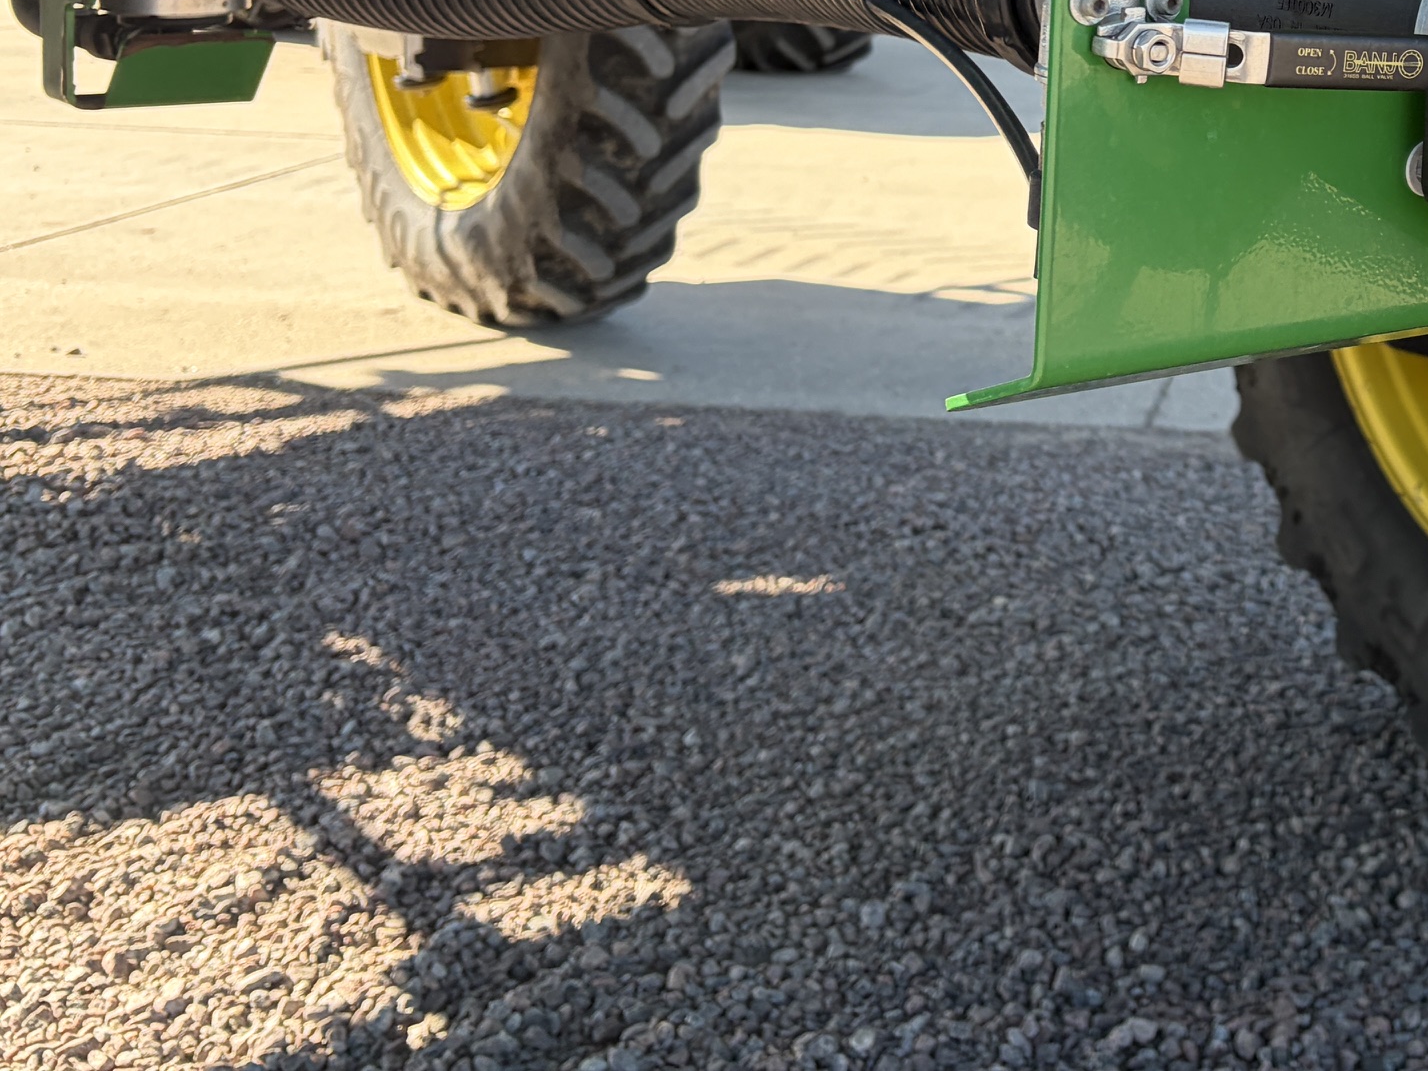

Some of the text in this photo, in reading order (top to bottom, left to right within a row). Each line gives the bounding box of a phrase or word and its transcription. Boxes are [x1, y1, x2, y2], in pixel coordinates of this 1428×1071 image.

[1297, 47, 1323, 58] OPEN
[1343, 49, 1424, 79] BANJO
[1295, 65, 1326, 76] CLOSE
